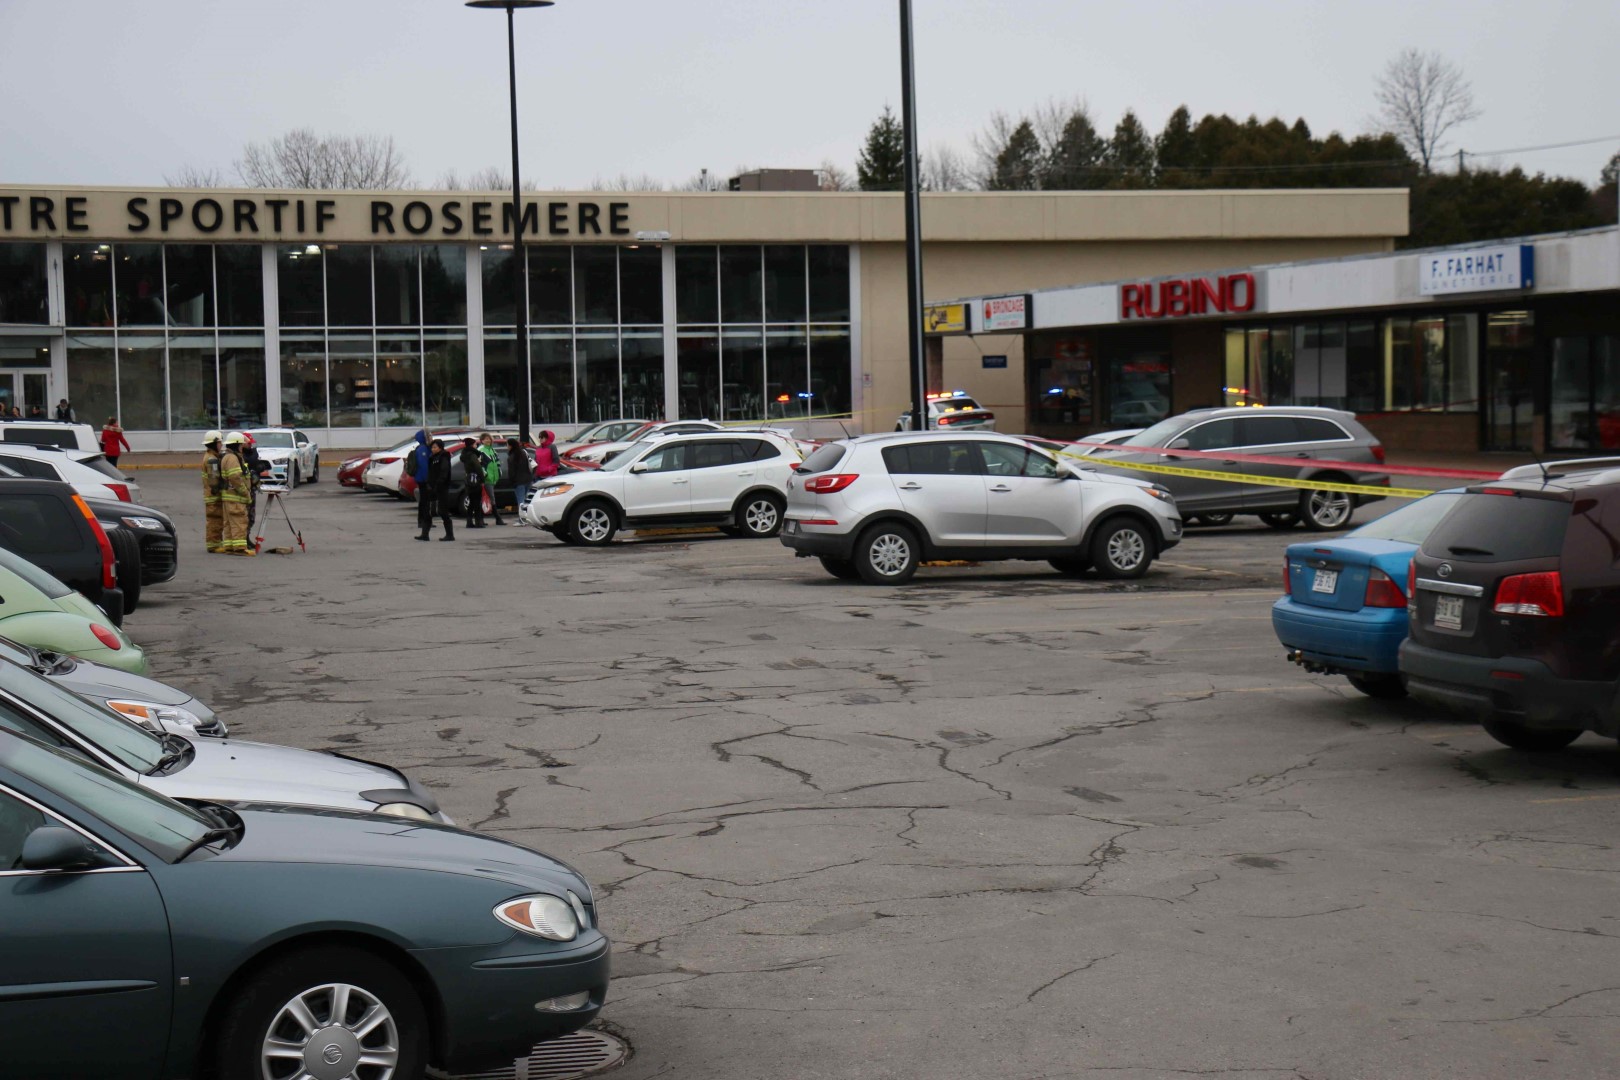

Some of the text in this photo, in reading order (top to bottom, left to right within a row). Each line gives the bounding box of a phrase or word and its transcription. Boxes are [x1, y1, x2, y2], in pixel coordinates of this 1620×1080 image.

[0, 196, 630, 235] TRE SPORTIF ROSEMERE
[1432, 253, 1504, 278] F. FARHAT
[1121, 273, 1256, 319] RUBINO
